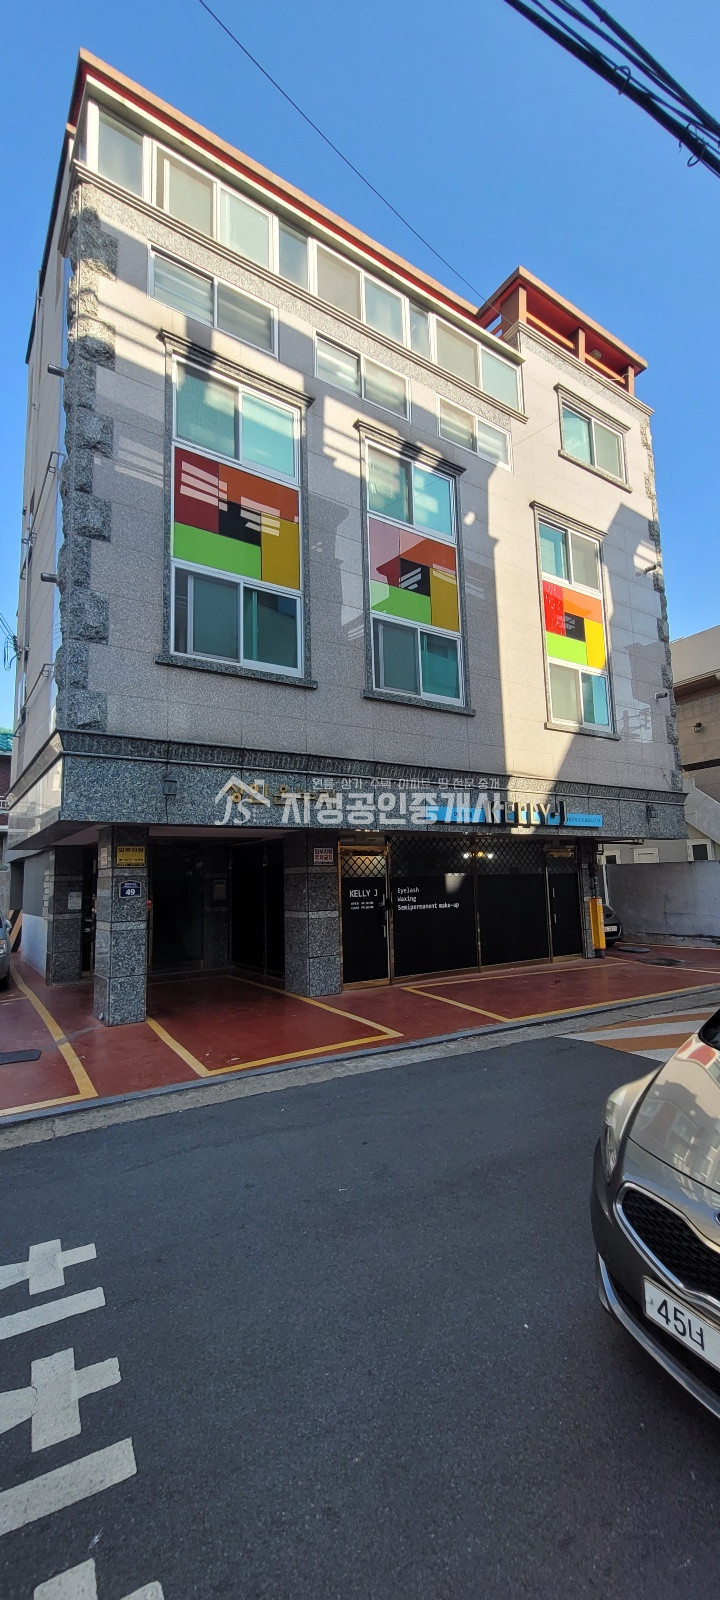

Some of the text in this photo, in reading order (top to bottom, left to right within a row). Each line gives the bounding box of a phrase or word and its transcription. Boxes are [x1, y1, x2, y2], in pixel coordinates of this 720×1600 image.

[125, 888, 136, 896] 49
[349, 889, 378, 898] KELLY J
[397, 886, 420, 895] Eyelash
[397, 903, 438, 911] Semipermanent
[656, 1298, 705, 1352] 45너
